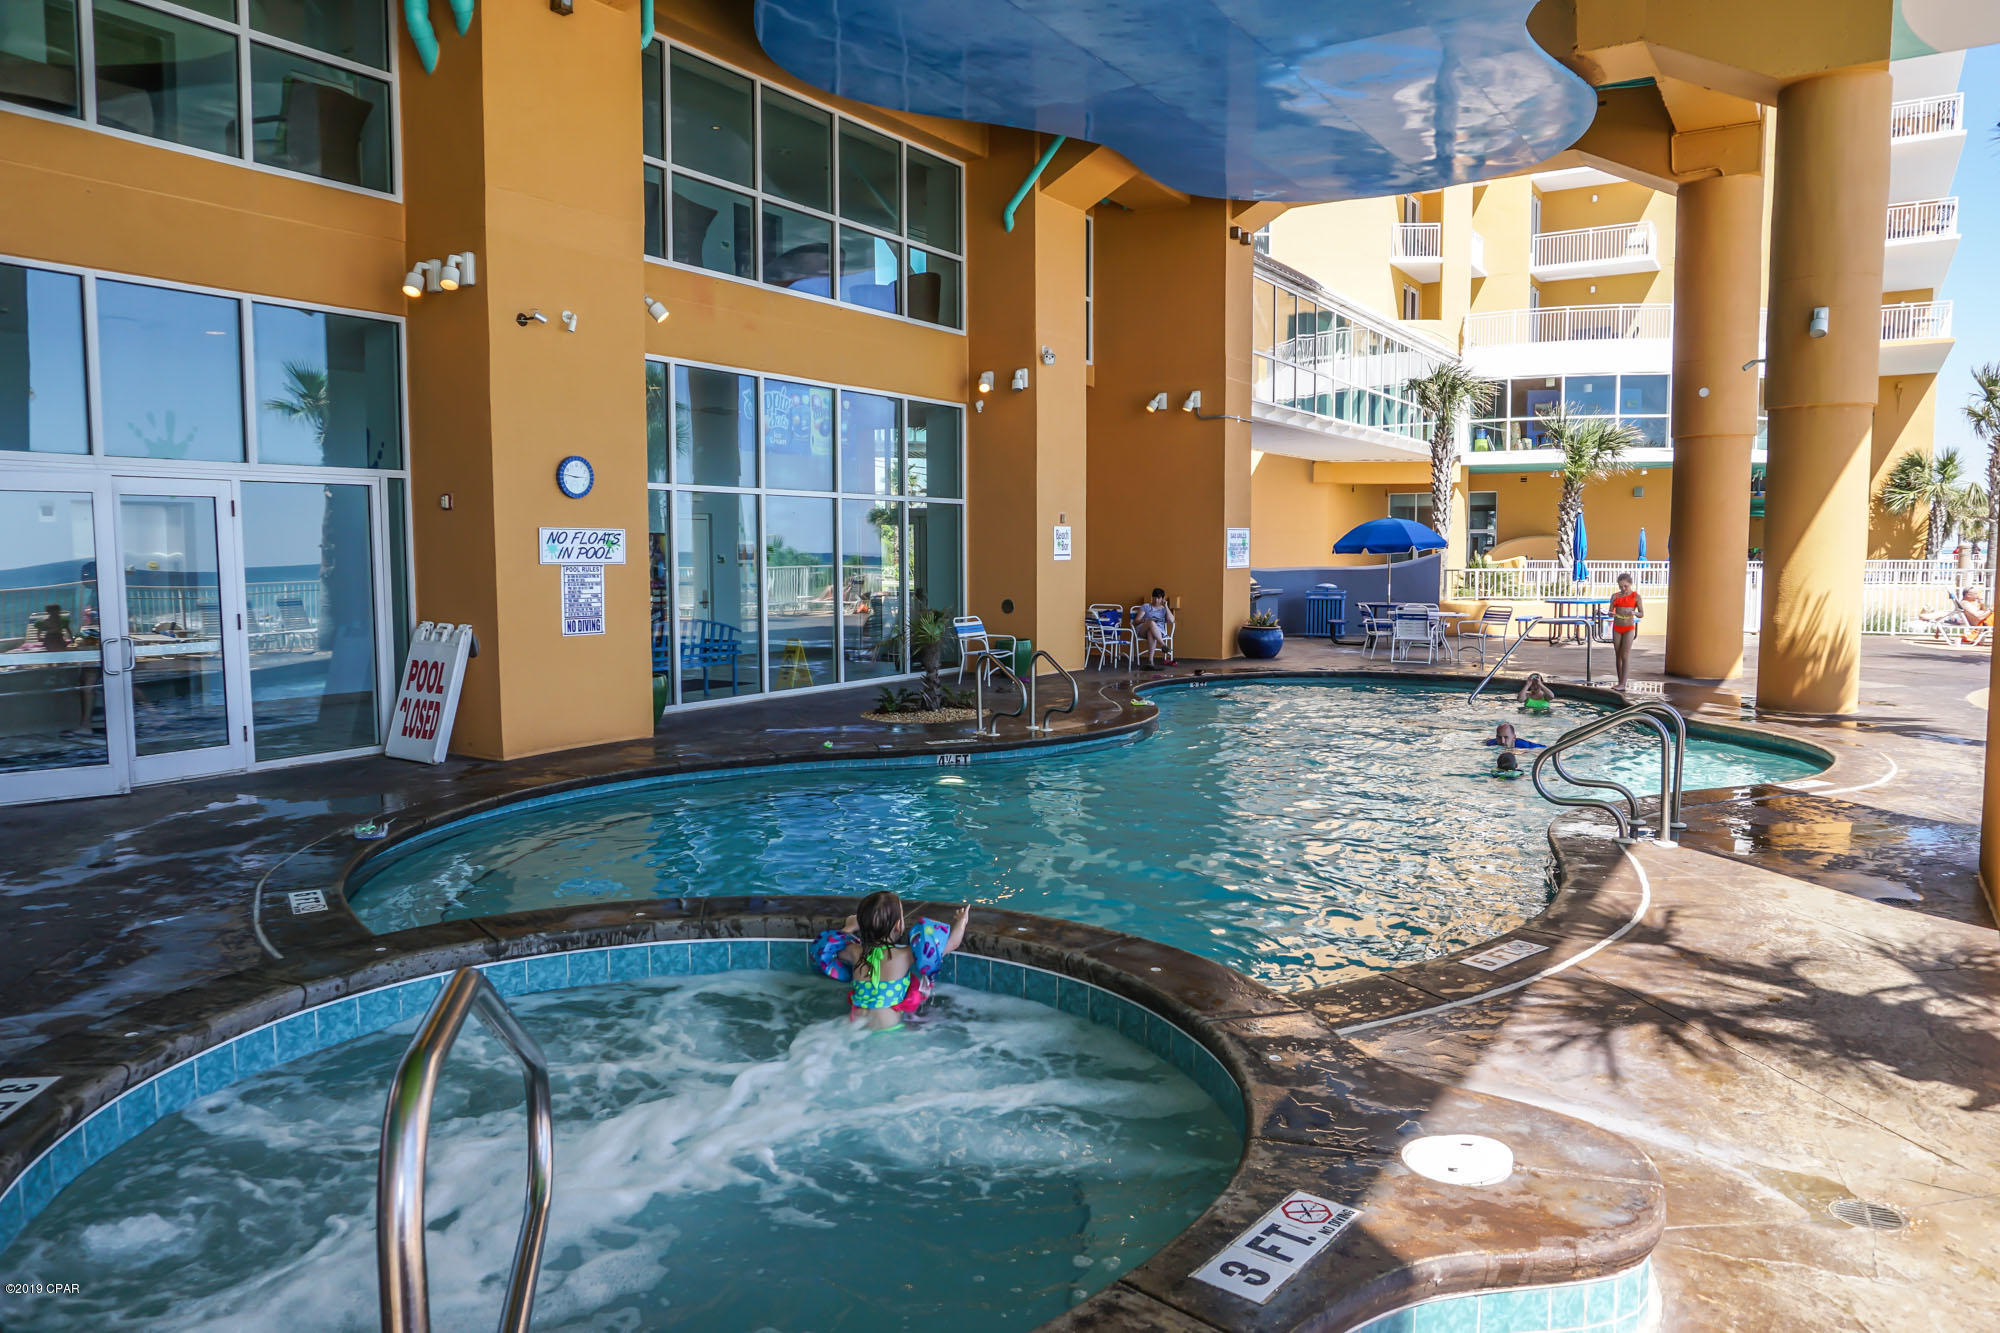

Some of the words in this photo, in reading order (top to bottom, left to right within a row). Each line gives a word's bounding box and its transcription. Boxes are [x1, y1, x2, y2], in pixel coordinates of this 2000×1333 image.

[546, 531, 568, 545] NO
[570, 531, 622, 545] FLOATS
[557, 546, 574, 559] IN
[576, 546, 613, 560] POOL
[566, 620, 577, 633] NO
[577, 618, 601, 633] DIVING
[405, 659, 445, 694] POOL
[1470, 957, 1498, 967] 5
[1317, 1225, 1336, 1236] NO
[1329, 1208, 1357, 1228] DIVING
[1219, 1260, 1271, 1286] 3
